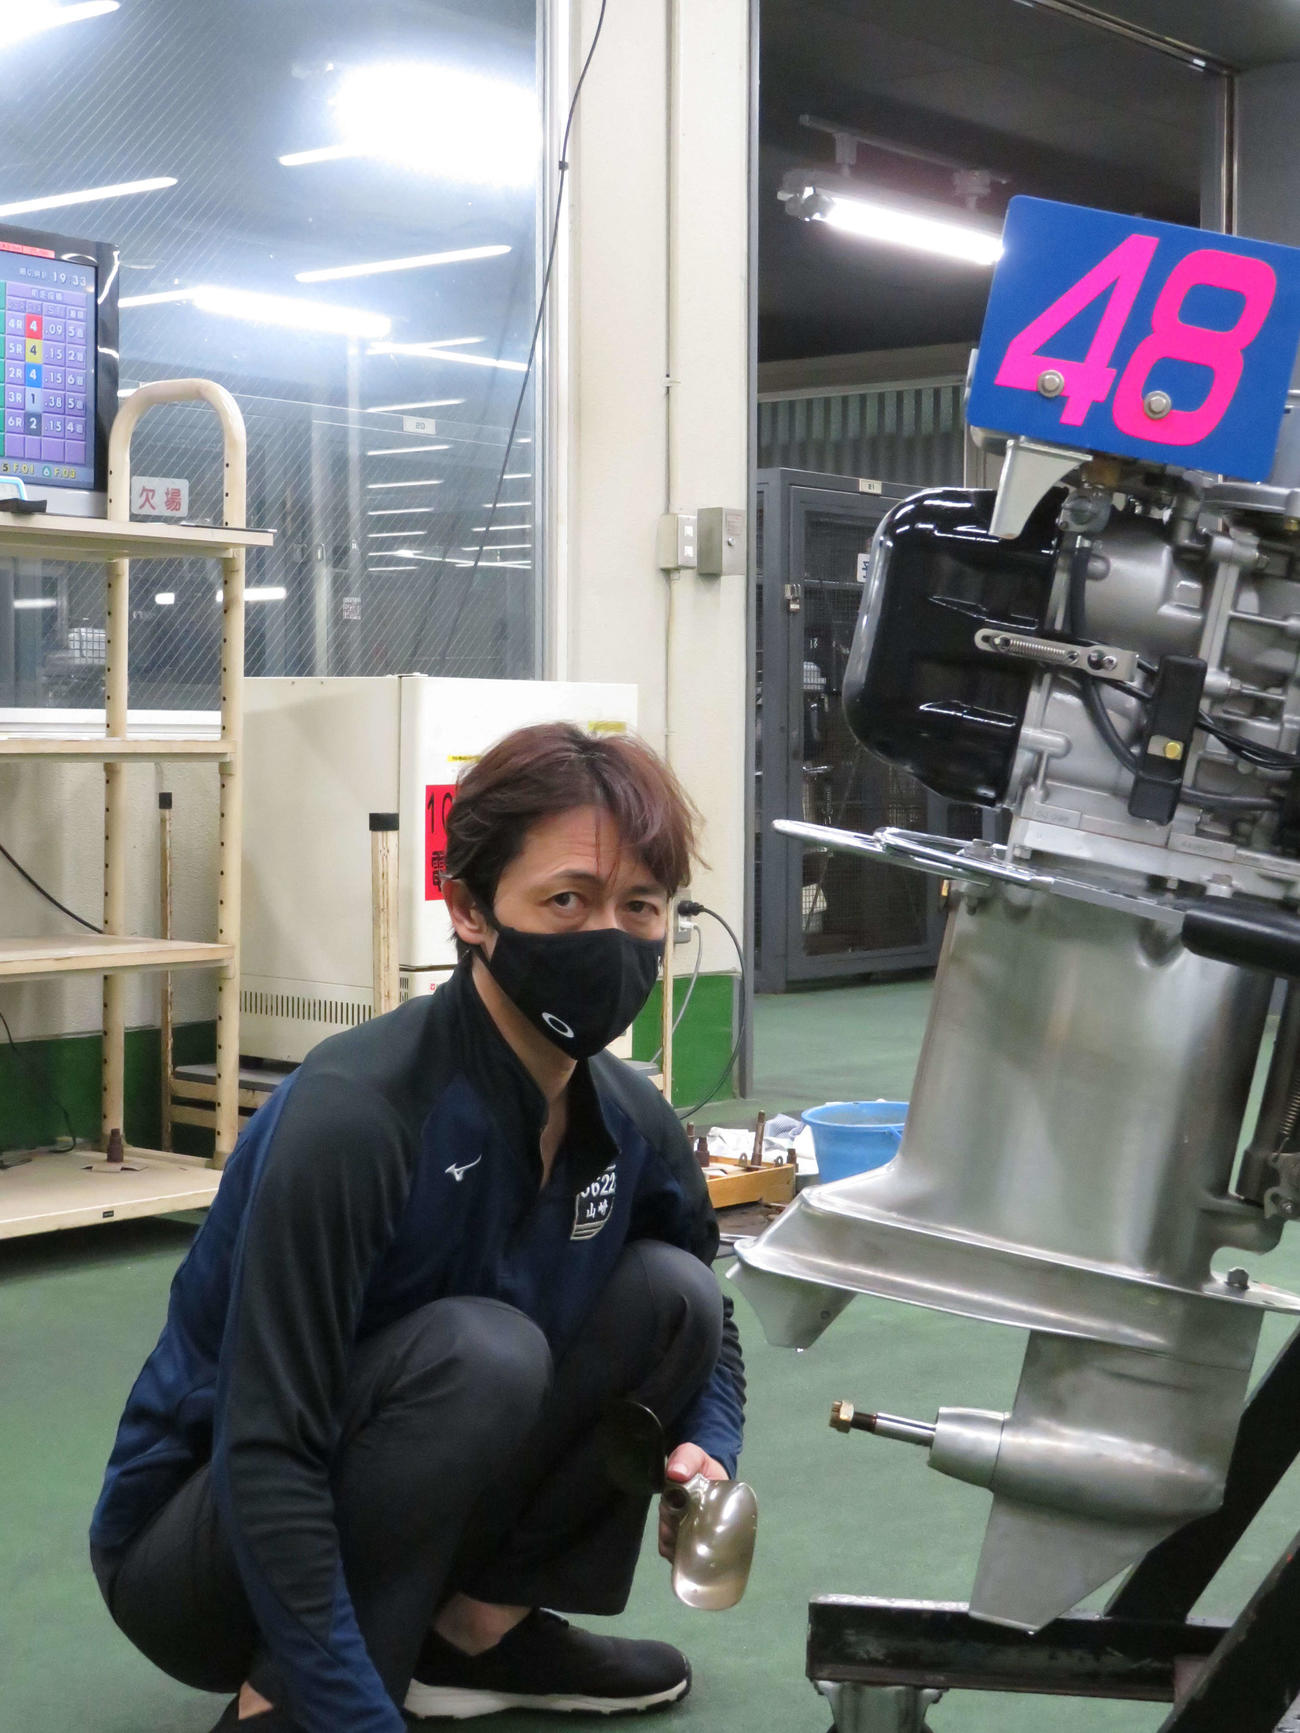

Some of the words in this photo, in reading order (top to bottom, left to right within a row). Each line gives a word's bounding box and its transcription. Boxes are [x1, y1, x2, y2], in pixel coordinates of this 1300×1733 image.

[8, 318, 23, 330] 4R
[29, 320, 38, 332] 4
[68, 326, 84, 338] 5
[994, 233, 1277, 446] 48
[8, 342, 22, 354] 5R
[29, 344, 37, 355] 4
[68, 350, 84, 362] 2
[8, 367, 22, 378] 2R
[29, 368, 37, 380] 4
[67, 374, 84, 386] 6
[8, 391, 22, 403] 3R
[31, 393, 36, 404] 1
[68, 398, 84, 410] 5
[8, 416, 22, 427] 6R
[29, 417, 37, 429] 2
[67, 422, 83, 433] 4
[138, 485, 182, 512] 欠場
